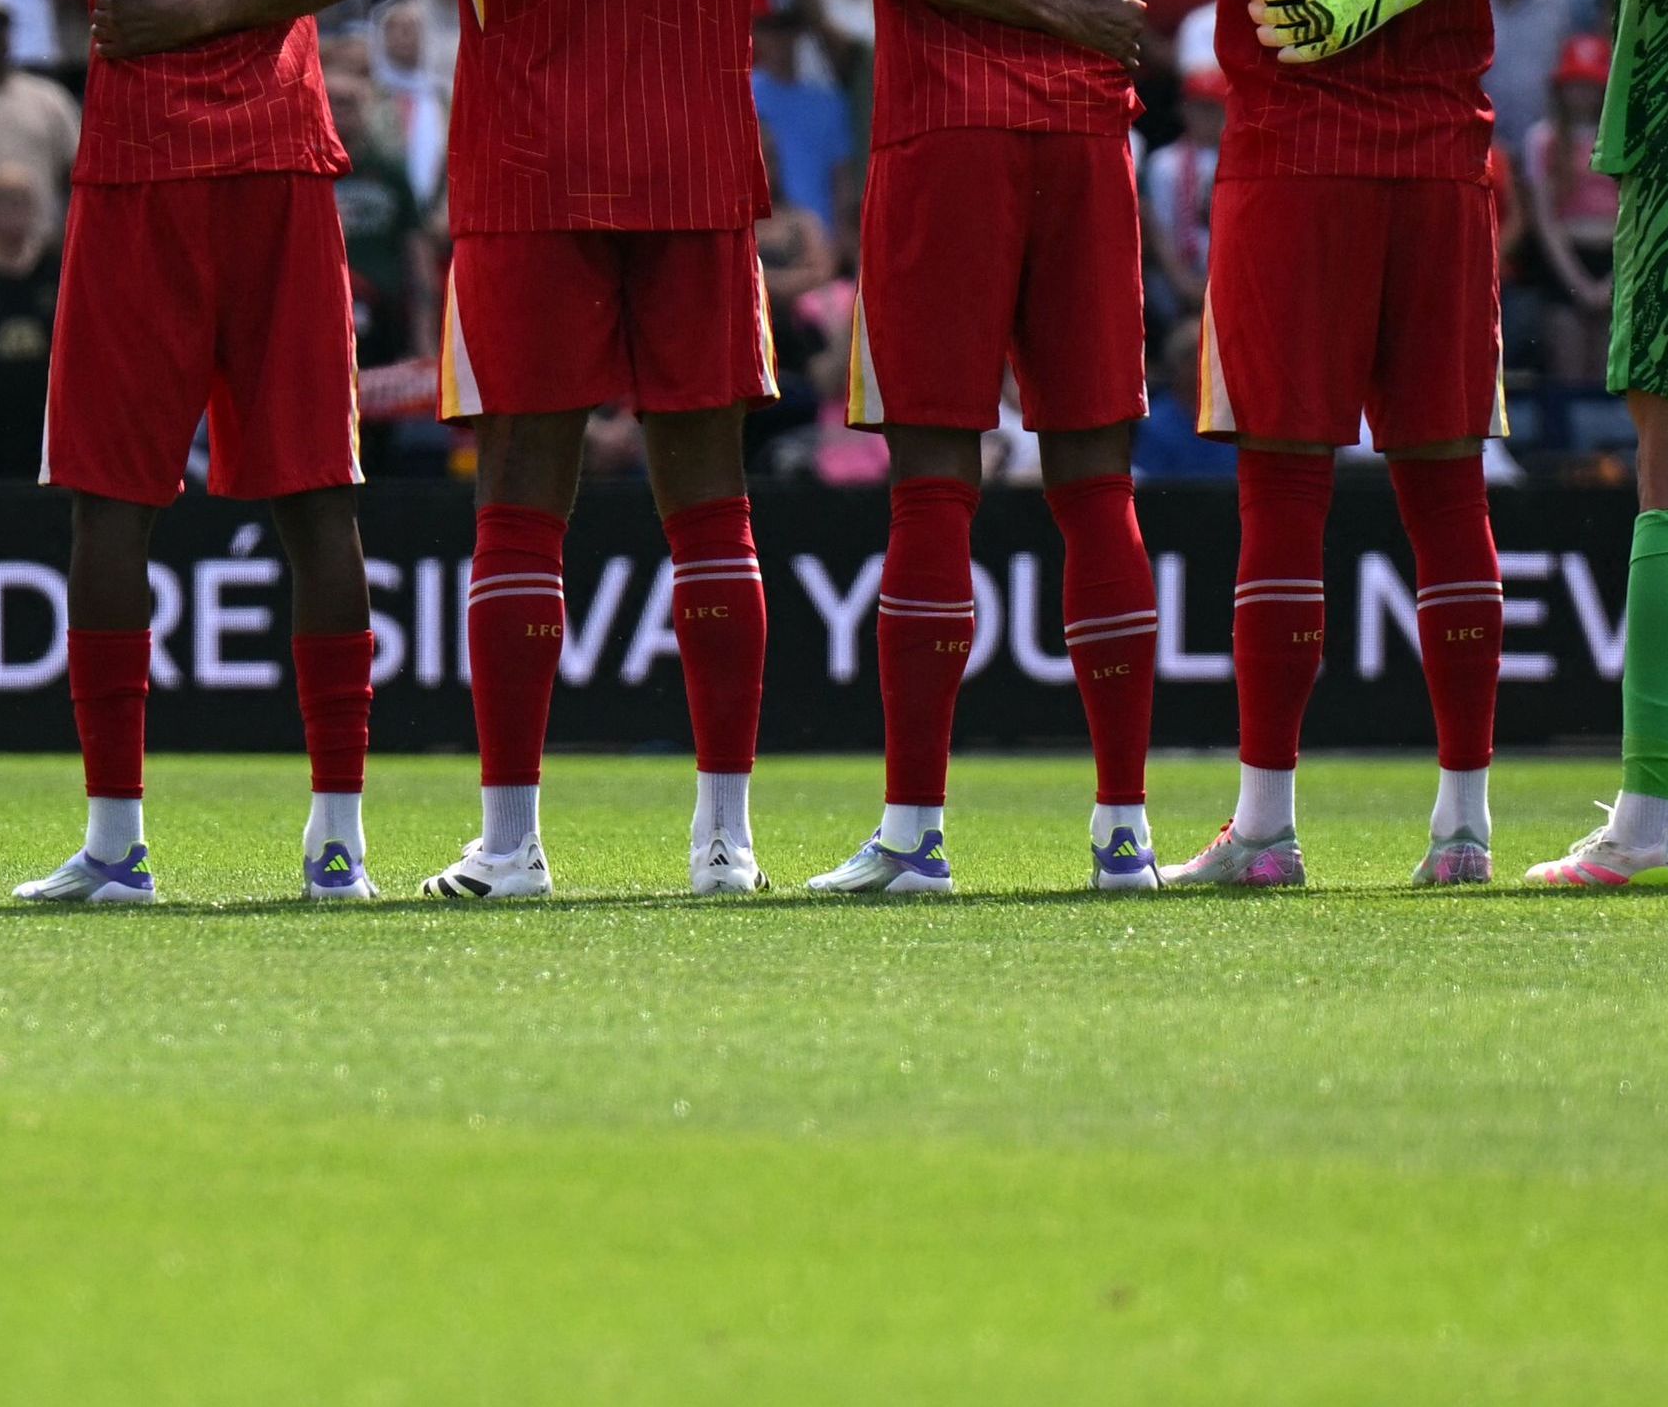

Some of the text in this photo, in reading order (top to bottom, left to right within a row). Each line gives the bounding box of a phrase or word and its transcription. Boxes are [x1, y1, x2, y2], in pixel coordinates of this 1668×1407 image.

[684, 606, 729, 620] LFC
[526, 623, 562, 638] LFC
[1292, 629, 1323, 643] LFC
[1446, 627, 1485, 642] LFC
[934, 640, 970, 653] LFC
[1093, 663, 1130, 680] LFC
